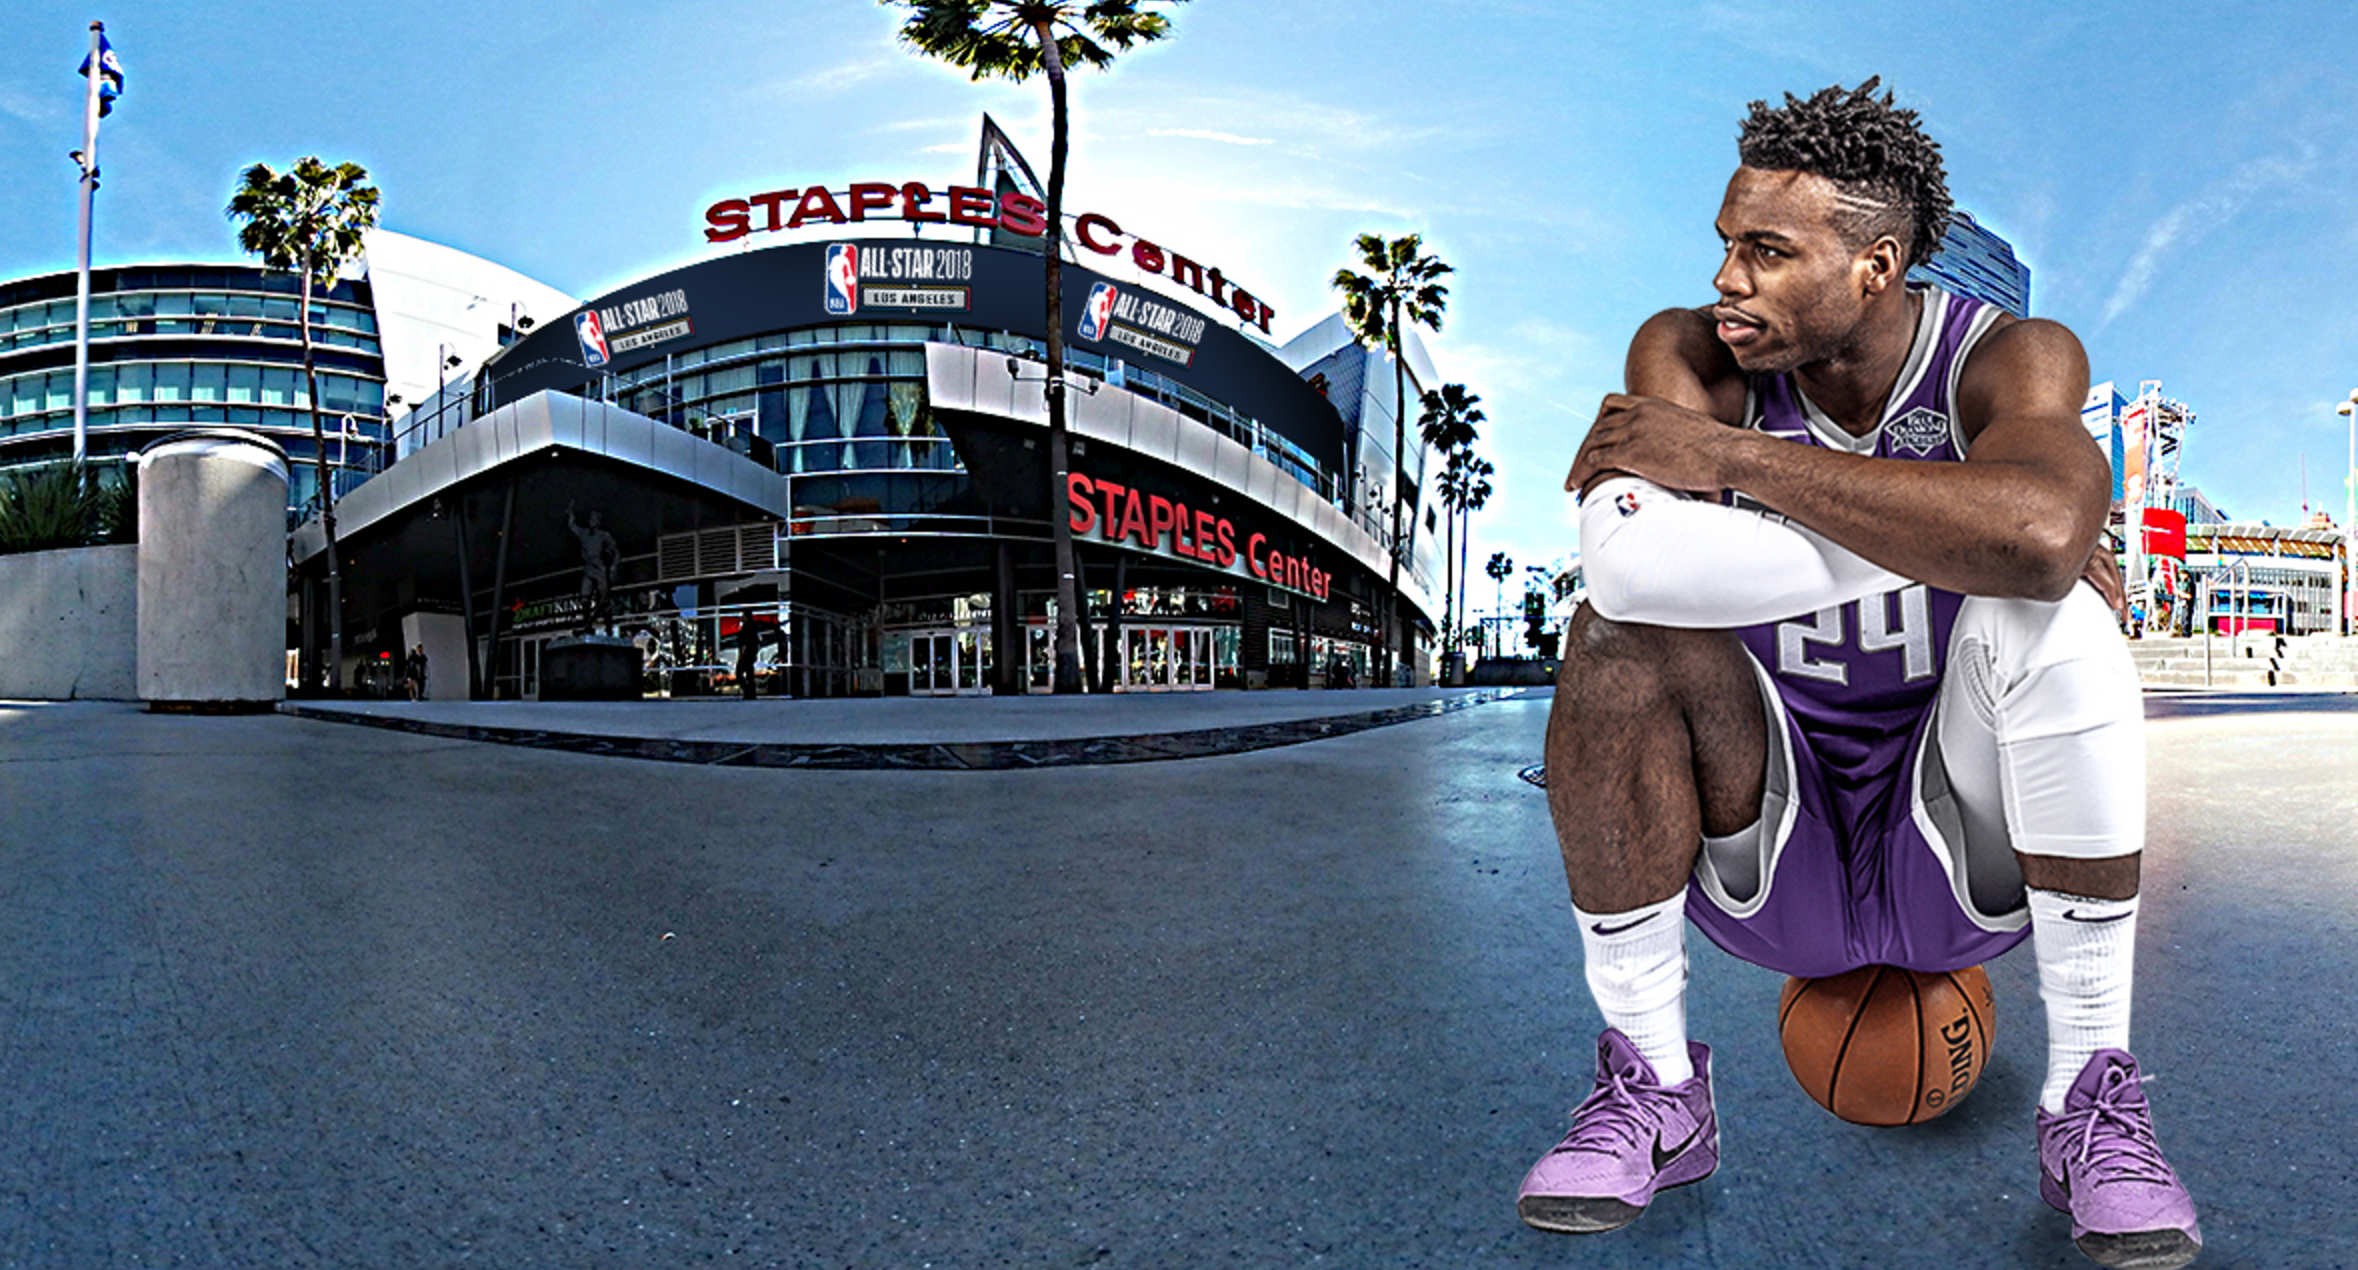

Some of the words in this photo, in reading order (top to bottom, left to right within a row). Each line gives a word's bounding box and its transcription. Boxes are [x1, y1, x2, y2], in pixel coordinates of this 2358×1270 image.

[704, 181, 1049, 244] STAPLES
[1075, 212, 1276, 335] Center
[936, 249, 972, 280] 2018
[657, 288, 689, 318] 2018
[873, 292, 897, 304] LOS
[901, 292, 955, 305] ANGELES
[1171, 311, 1205, 345] 2018
[1067, 471, 1237, 568] STAPLES
[1247, 532, 1333, 600] Center
[1777, 583, 1936, 686] 24
